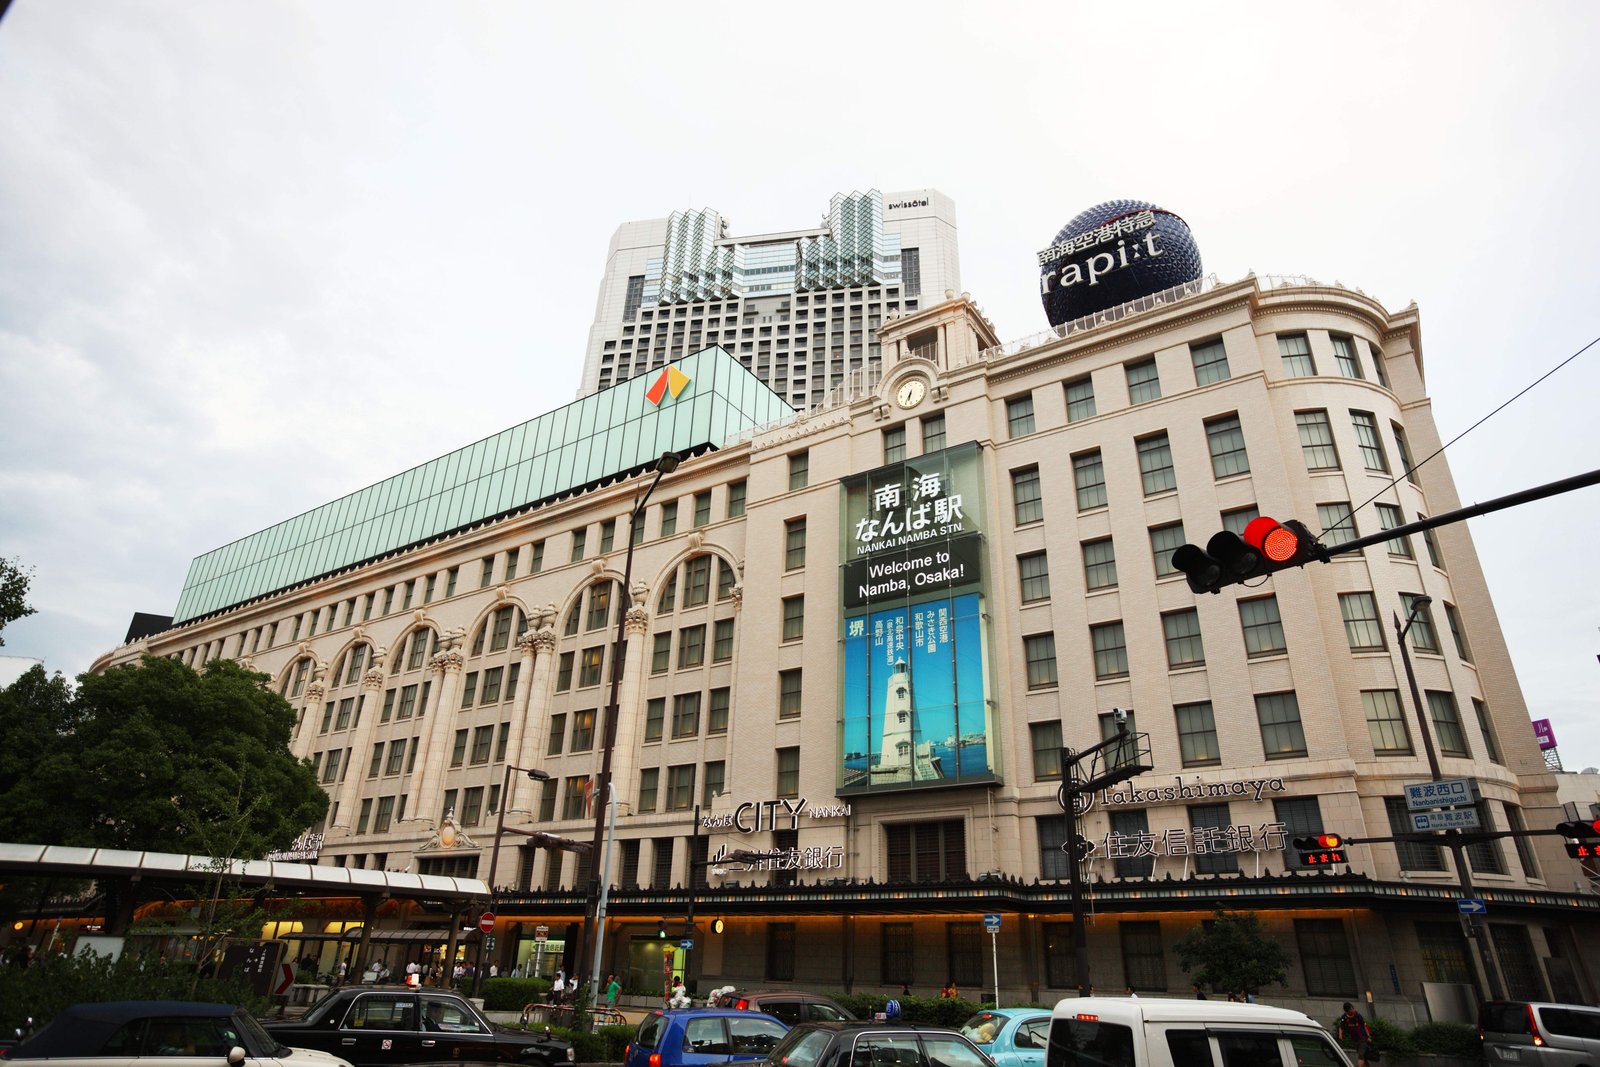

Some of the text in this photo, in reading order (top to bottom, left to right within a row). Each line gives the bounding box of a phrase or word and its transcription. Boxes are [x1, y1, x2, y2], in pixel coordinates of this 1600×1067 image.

[1037, 210, 1156, 267] 南海空港特急
[874, 472, 941, 512] 南海
[855, 494, 964, 542] なんば駅
[856, 522, 965, 555] NANKAI NAMBA STN.
[859, 564, 964, 598] Namba, Osaka!
[869, 551, 950, 579] Welcome to
[848, 620, 864, 637] 堺
[874, 620, 884, 647] 高野山
[895, 616, 905, 651] 和泉中央
[914, 612, 924, 648] 和歌山市
[926, 610, 937, 654] みさき公園
[938, 607, 949, 643] 関西空港
[1409, 782, 1465, 799] 難波西口
[1412, 795, 1468, 807] Nanbanishiguchi
[734, 797, 808, 835] CITY
[808, 804, 852, 819] NANKAI
[1102, 821, 1289, 861] 住友信託銀行
[1308, 852, 1341, 864] 止まれ
[729, 845, 845, 873] 井住友銀行
